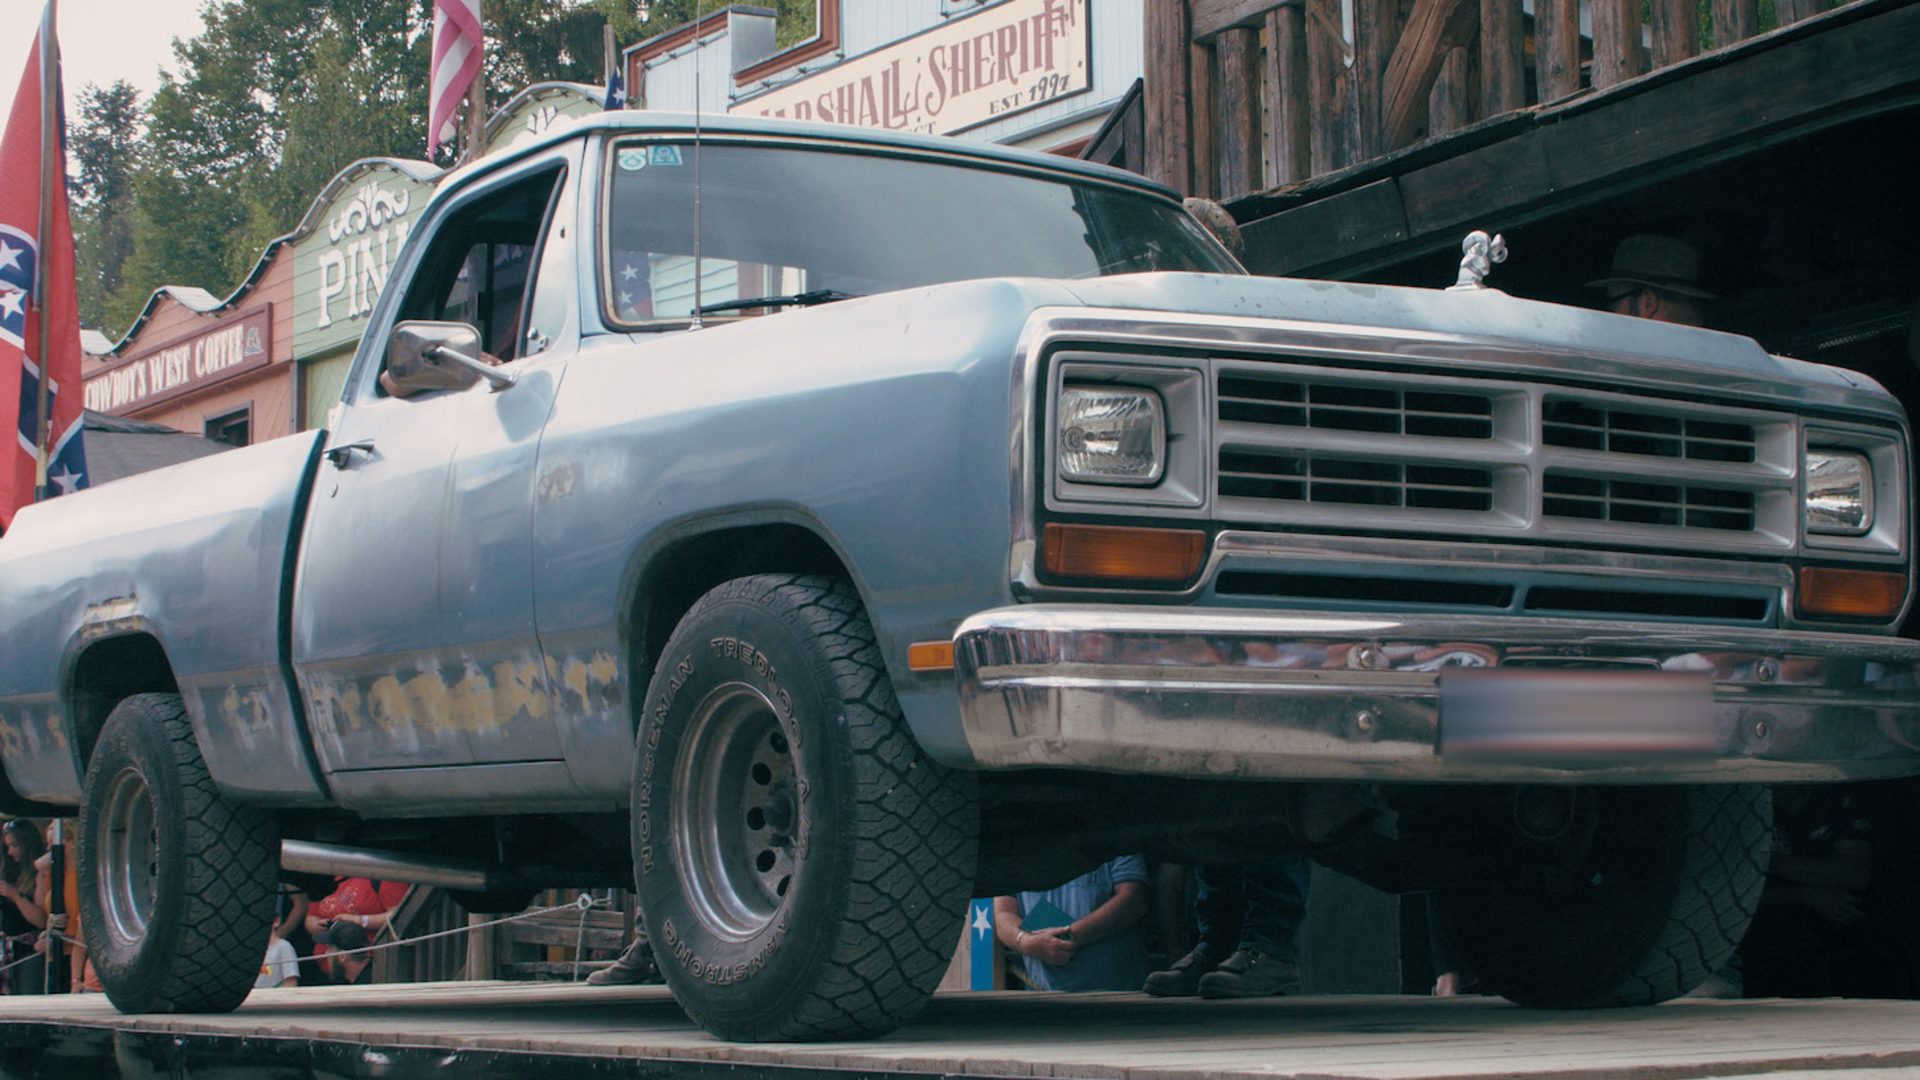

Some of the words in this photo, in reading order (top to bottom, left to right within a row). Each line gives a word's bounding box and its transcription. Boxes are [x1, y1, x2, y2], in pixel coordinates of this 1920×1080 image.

[760, 58, 921, 129] SHALL
[924, 0, 1076, 116] SHERIFF
[989, 92, 1023, 115] EST
[1029, 73, 1070, 102] 1997
[149, 344, 191, 395] WEST
[195, 323, 244, 378] COFFEE
[640, 655, 695, 874] NORSEMAN
[662, 909, 791, 985] ARMSTRONG
